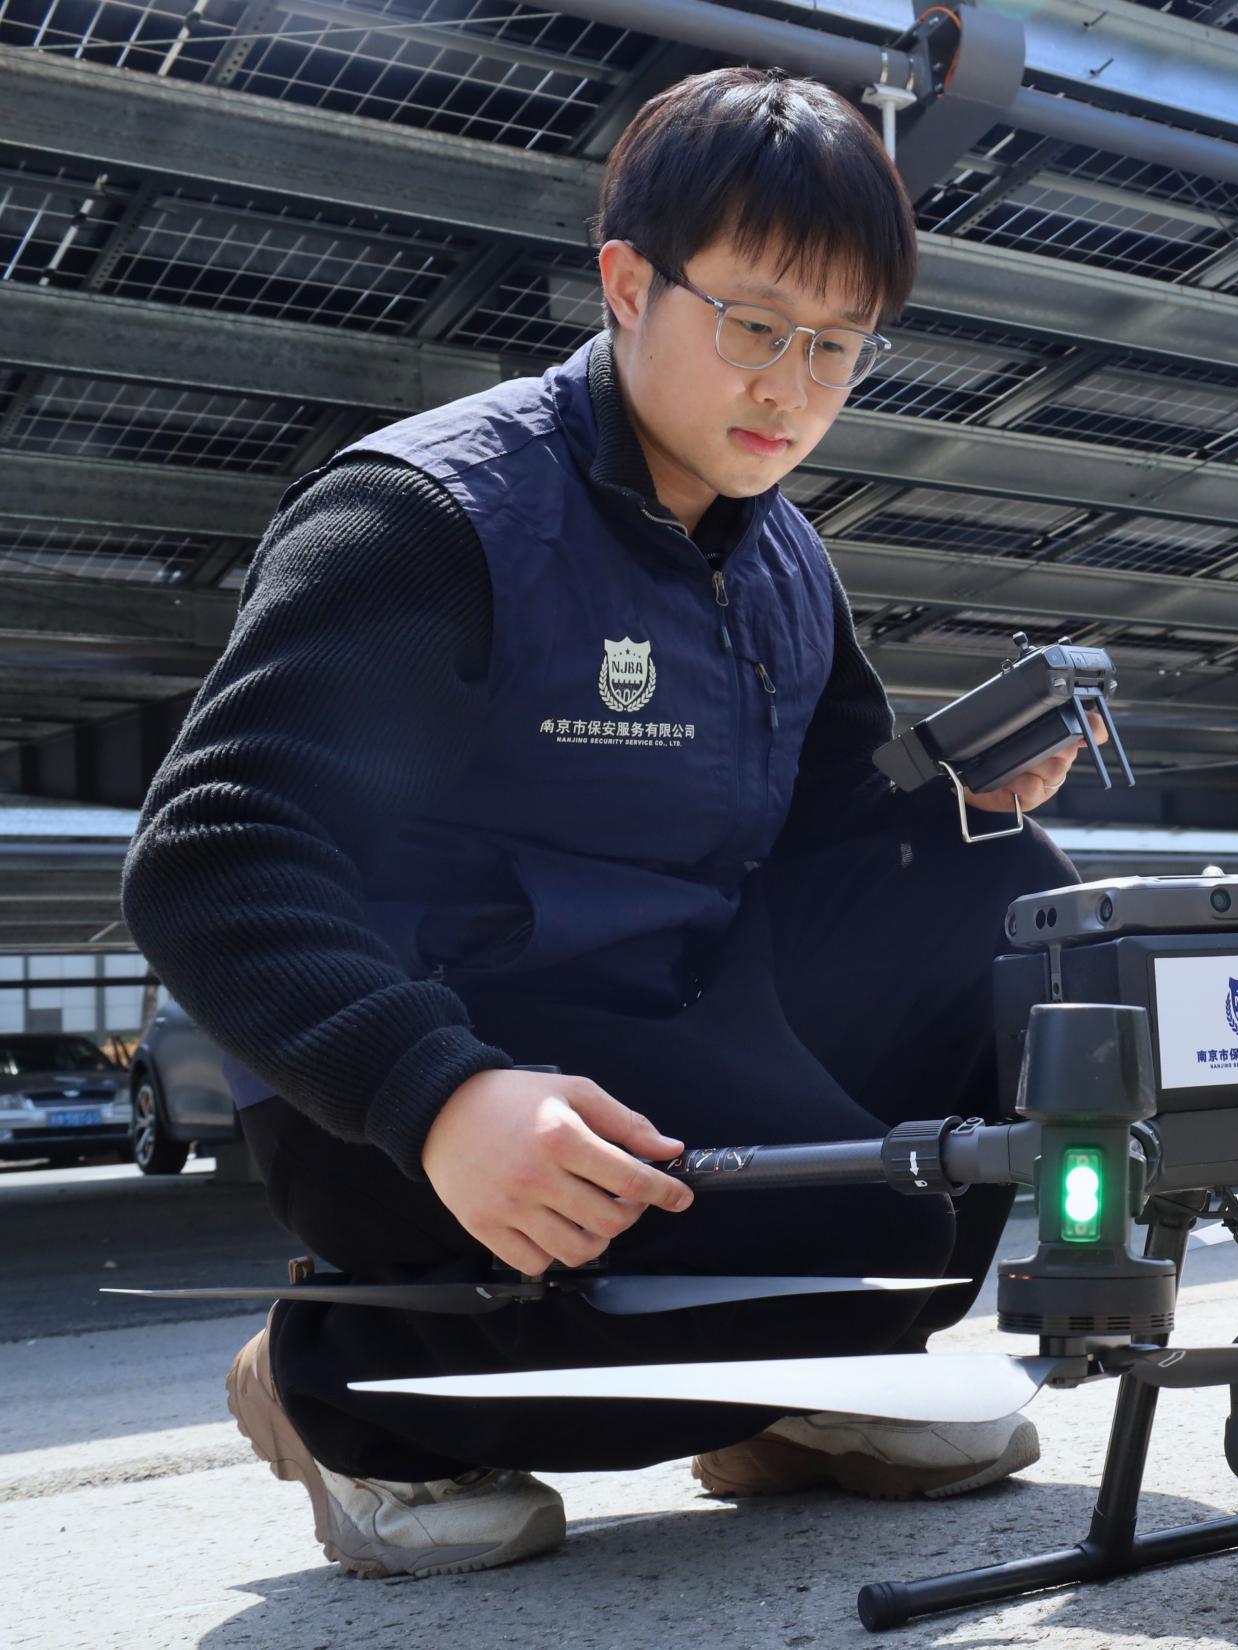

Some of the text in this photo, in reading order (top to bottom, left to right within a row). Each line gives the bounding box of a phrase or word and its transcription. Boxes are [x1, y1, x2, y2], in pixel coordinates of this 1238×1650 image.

[611, 661, 643, 674] NJBA
[540, 719, 695, 739] 南京市保安服务有限公司
